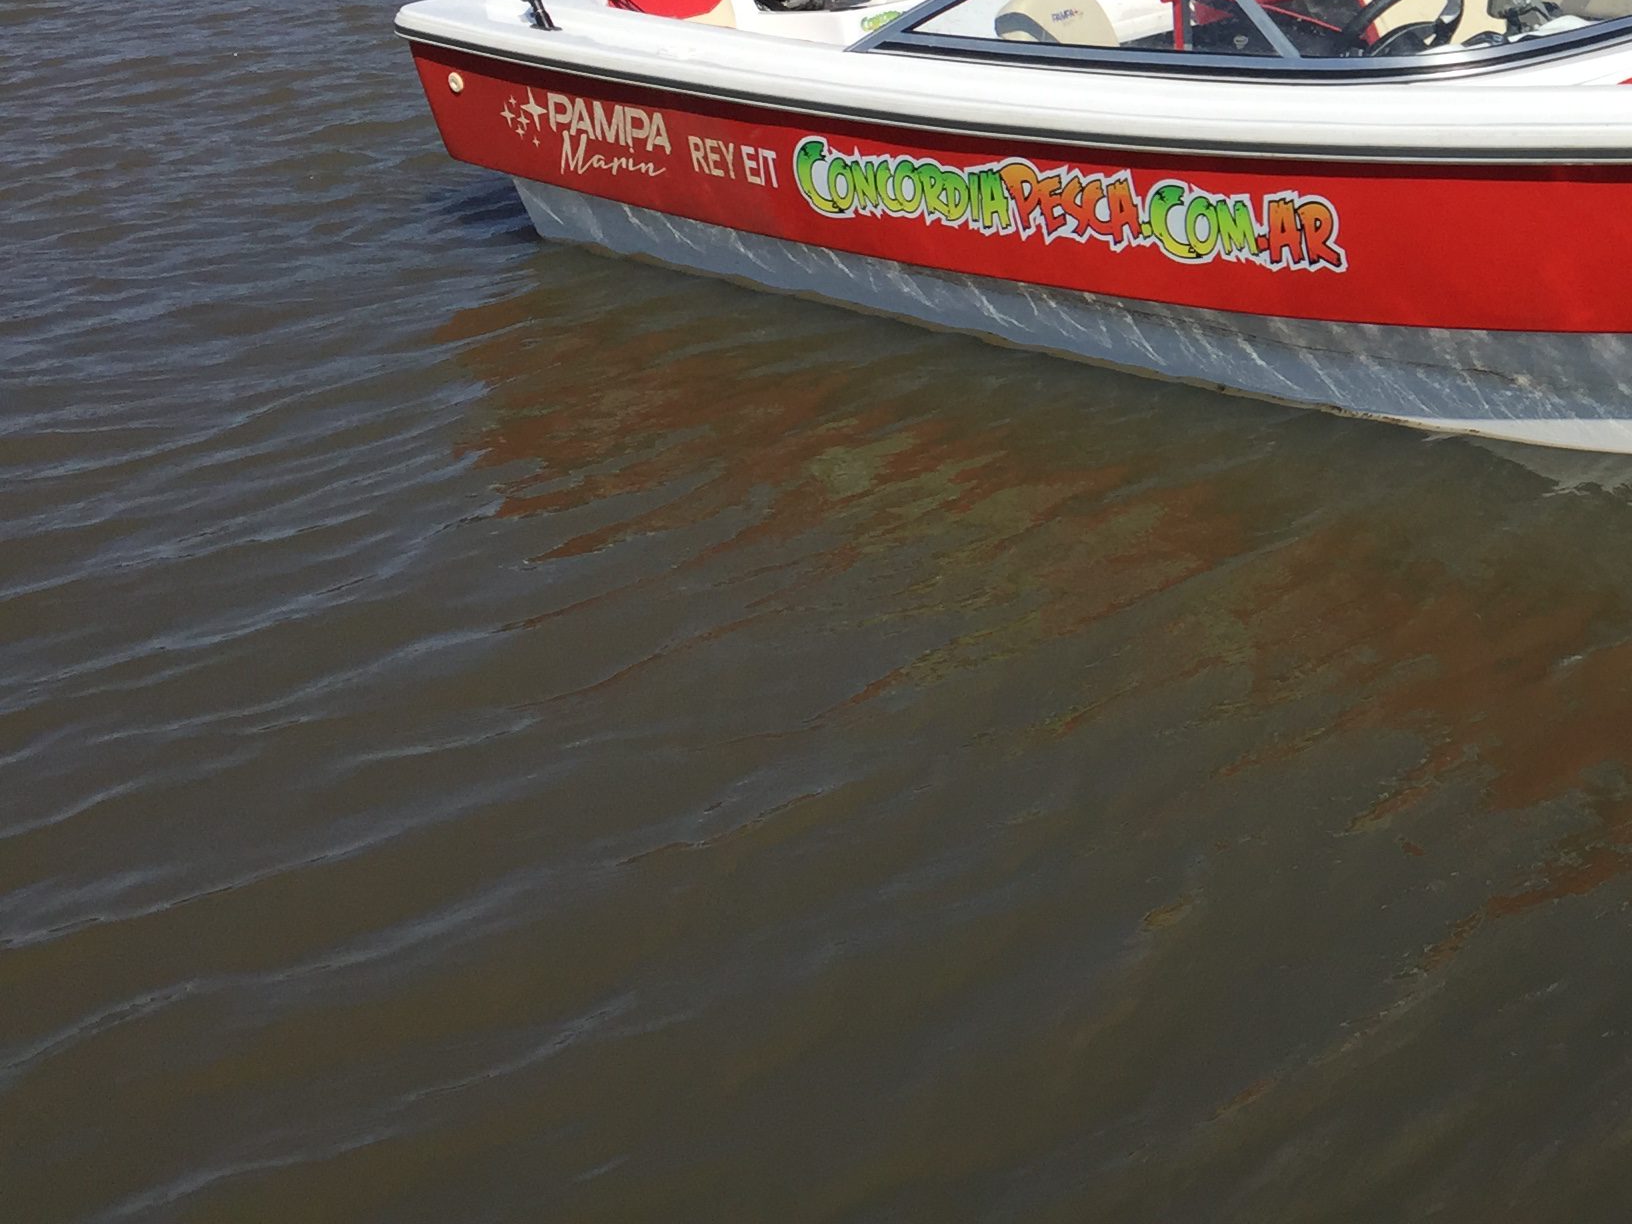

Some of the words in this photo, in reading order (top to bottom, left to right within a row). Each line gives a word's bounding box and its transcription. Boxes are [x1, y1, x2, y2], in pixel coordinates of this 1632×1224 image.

[547, 92, 672, 155] PAMPA
[560, 129, 667, 177] Marin
[687, 135, 736, 180] REY
